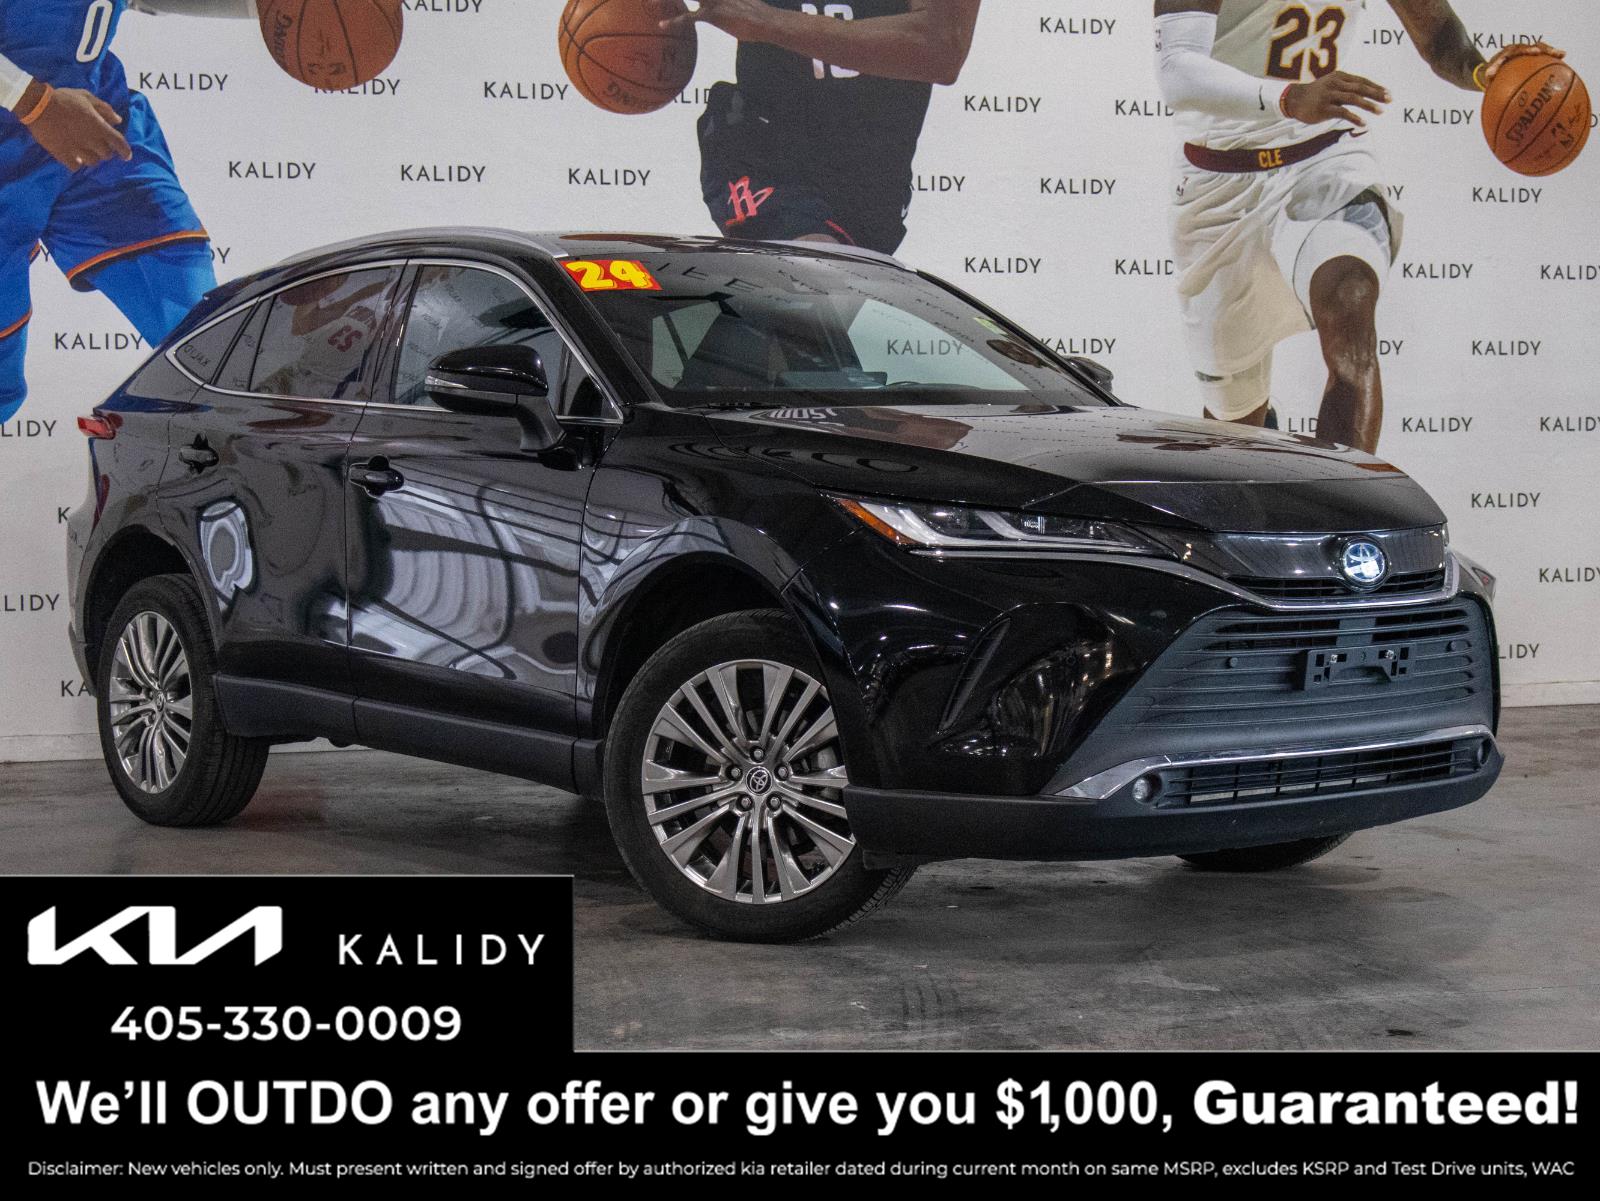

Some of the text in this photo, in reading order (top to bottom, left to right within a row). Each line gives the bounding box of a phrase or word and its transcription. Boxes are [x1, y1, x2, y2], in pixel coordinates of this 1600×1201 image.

[1041, 16, 1116, 35] KALIDY
[1265, 6, 1346, 80] 23
[1364, 29, 1404, 46] IDY
[140, 72, 228, 91] KALIDY
[484, 81, 568, 100] KALIDY
[964, 95, 1041, 113] KALIDY
[1115, 100, 1174, 117] KALI
[1403, 107, 1474, 125] KALIDY
[1258, 149, 1283, 168] CLE
[228, 160, 316, 180] KALIDY
[400, 164, 486, 183] KALIDY
[568, 167, 651, 186] KALIDY
[910, 176, 965, 192] LIDY
[1040, 177, 1116, 195] KALIDY
[1472, 187, 1543, 204] KALIDY
[965, 257, 1042, 274] KALIDY
[1115, 259, 1173, 276] KALID
[1402, 263, 1473, 279] KALIDY
[1541, 265, 1600, 281] KALID
[566, 260, 652, 291] 24
[55, 332, 143, 351] KALIDY
[887, 339, 965, 356] KALIDY
[1472, 340, 1541, 356] KALIDY
[0, 420, 57, 438] LIDY
[1288, 417, 1319, 433] LID
[1402, 416, 1473, 433] KALIDY
[1540, 416, 1600, 432] KALID
[1471, 492, 1541, 508] KALIDY
[0, 595, 60, 613] LIDY
